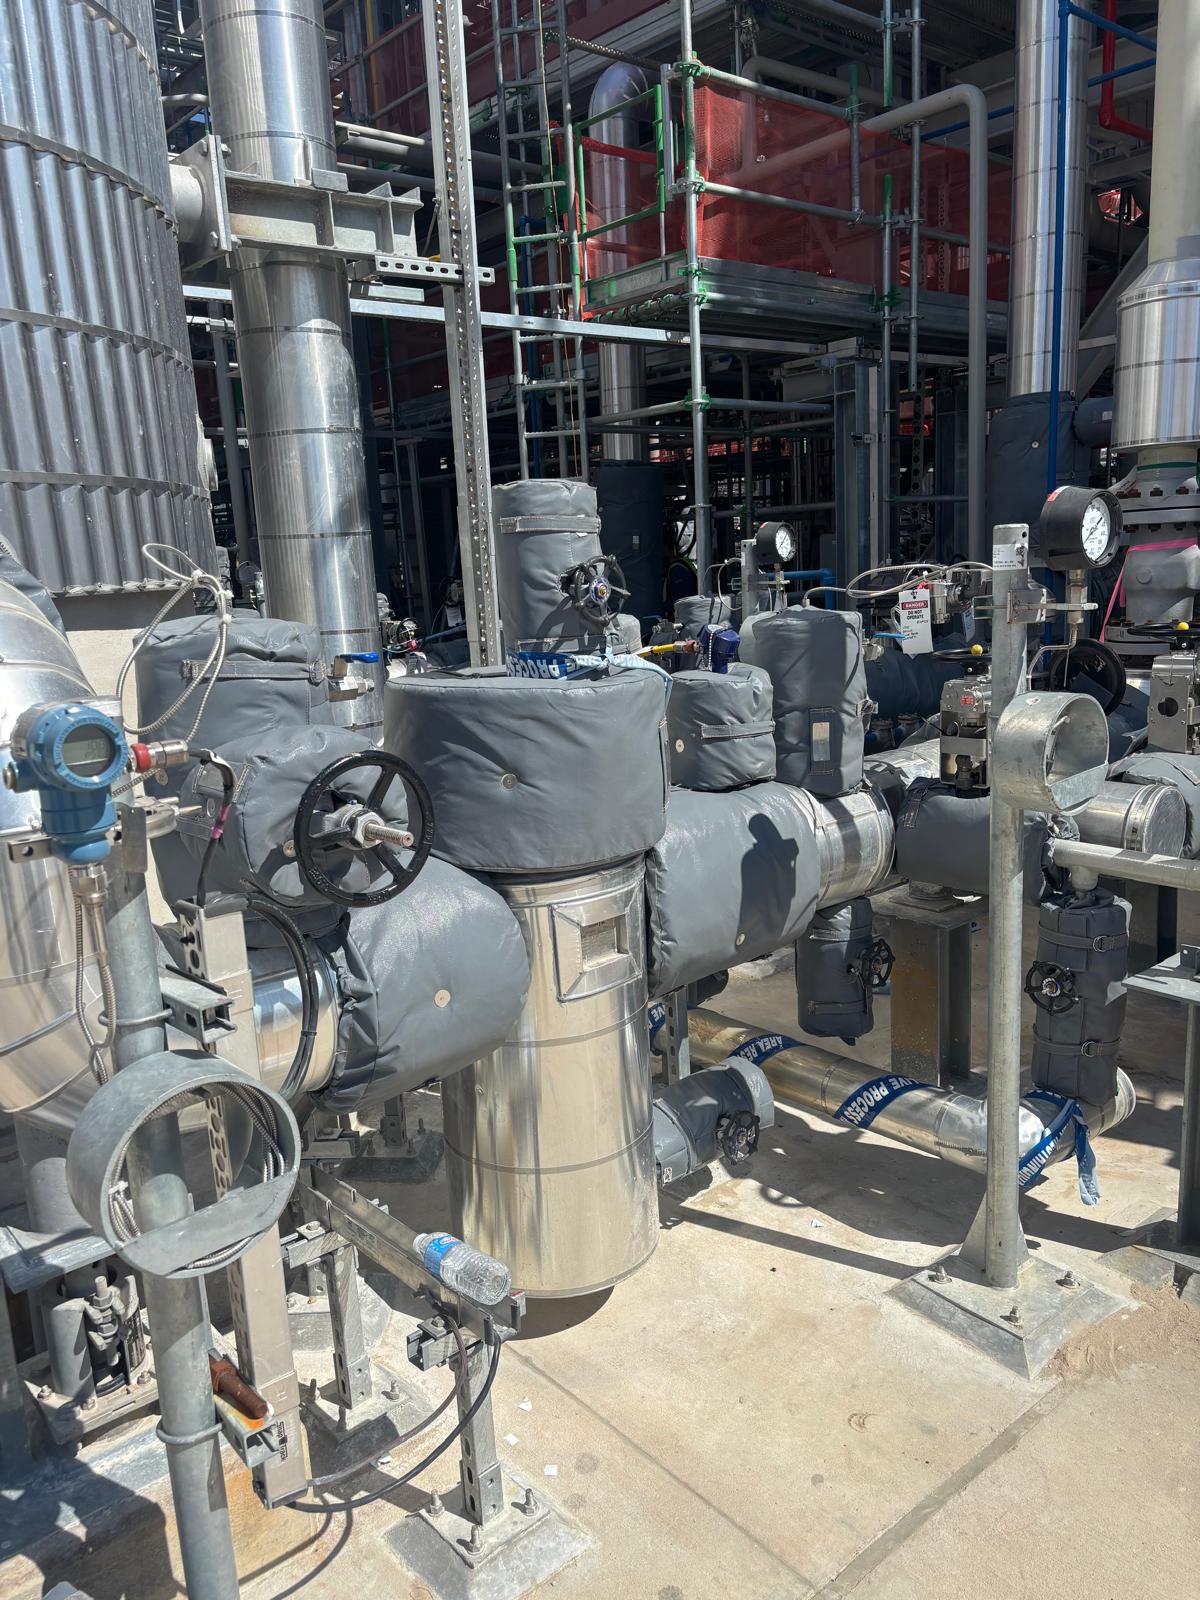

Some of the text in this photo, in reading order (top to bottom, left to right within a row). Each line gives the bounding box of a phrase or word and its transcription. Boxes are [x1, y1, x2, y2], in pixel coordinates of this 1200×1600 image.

[738, 1043, 758, 1062] RES
[843, 1077, 920, 1125] LIVE PROCESS
